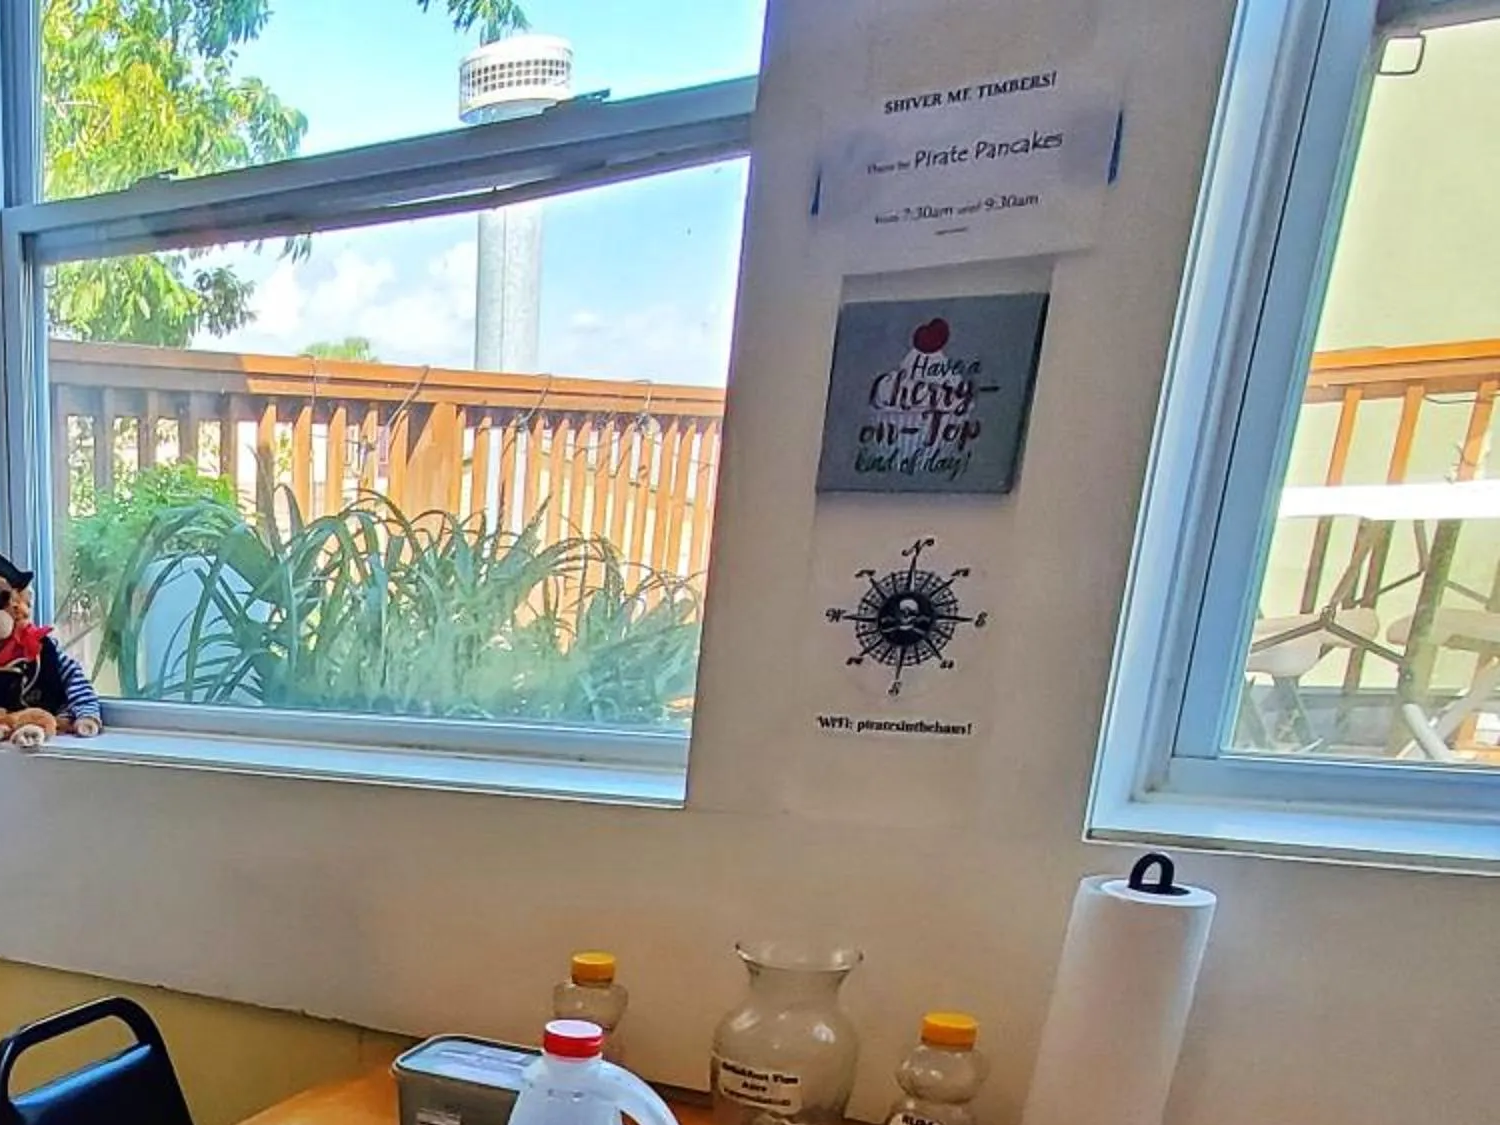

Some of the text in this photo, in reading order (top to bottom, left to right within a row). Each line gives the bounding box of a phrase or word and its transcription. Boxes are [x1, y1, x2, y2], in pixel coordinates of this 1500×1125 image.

[884, 70, 1058, 114] SHIVER ME TIMBERS!
[914, 146, 969, 169] Pirate
[975, 131, 1064, 161] Pancakes
[911, 354, 963, 380] Have
